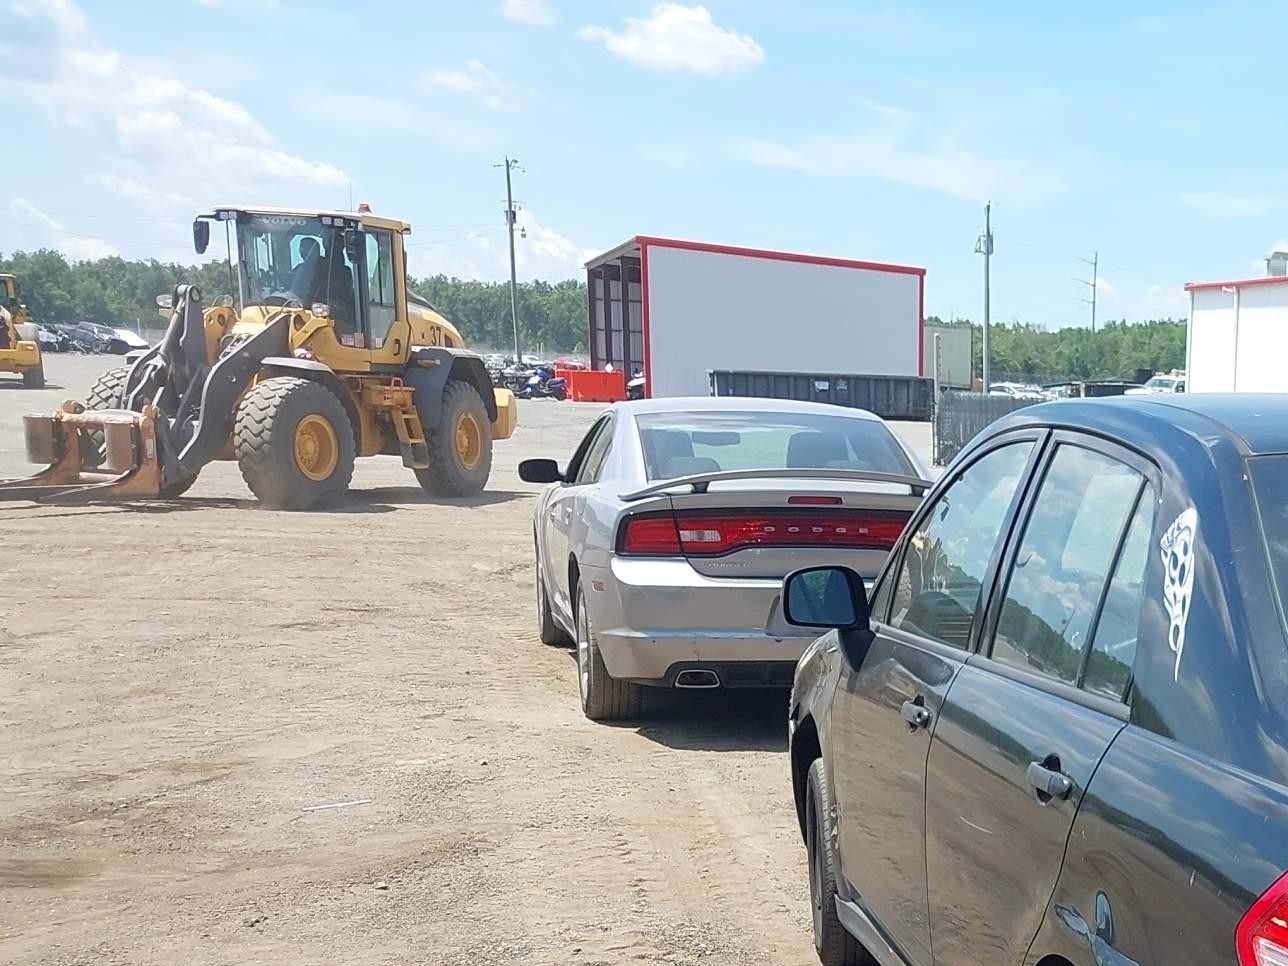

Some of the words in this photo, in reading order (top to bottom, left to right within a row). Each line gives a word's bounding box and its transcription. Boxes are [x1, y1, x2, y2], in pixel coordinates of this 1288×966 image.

[261, 216, 306, 225] VOLVO
[430, 325, 442, 347] 37
[763, 526, 869, 534] DODGE
